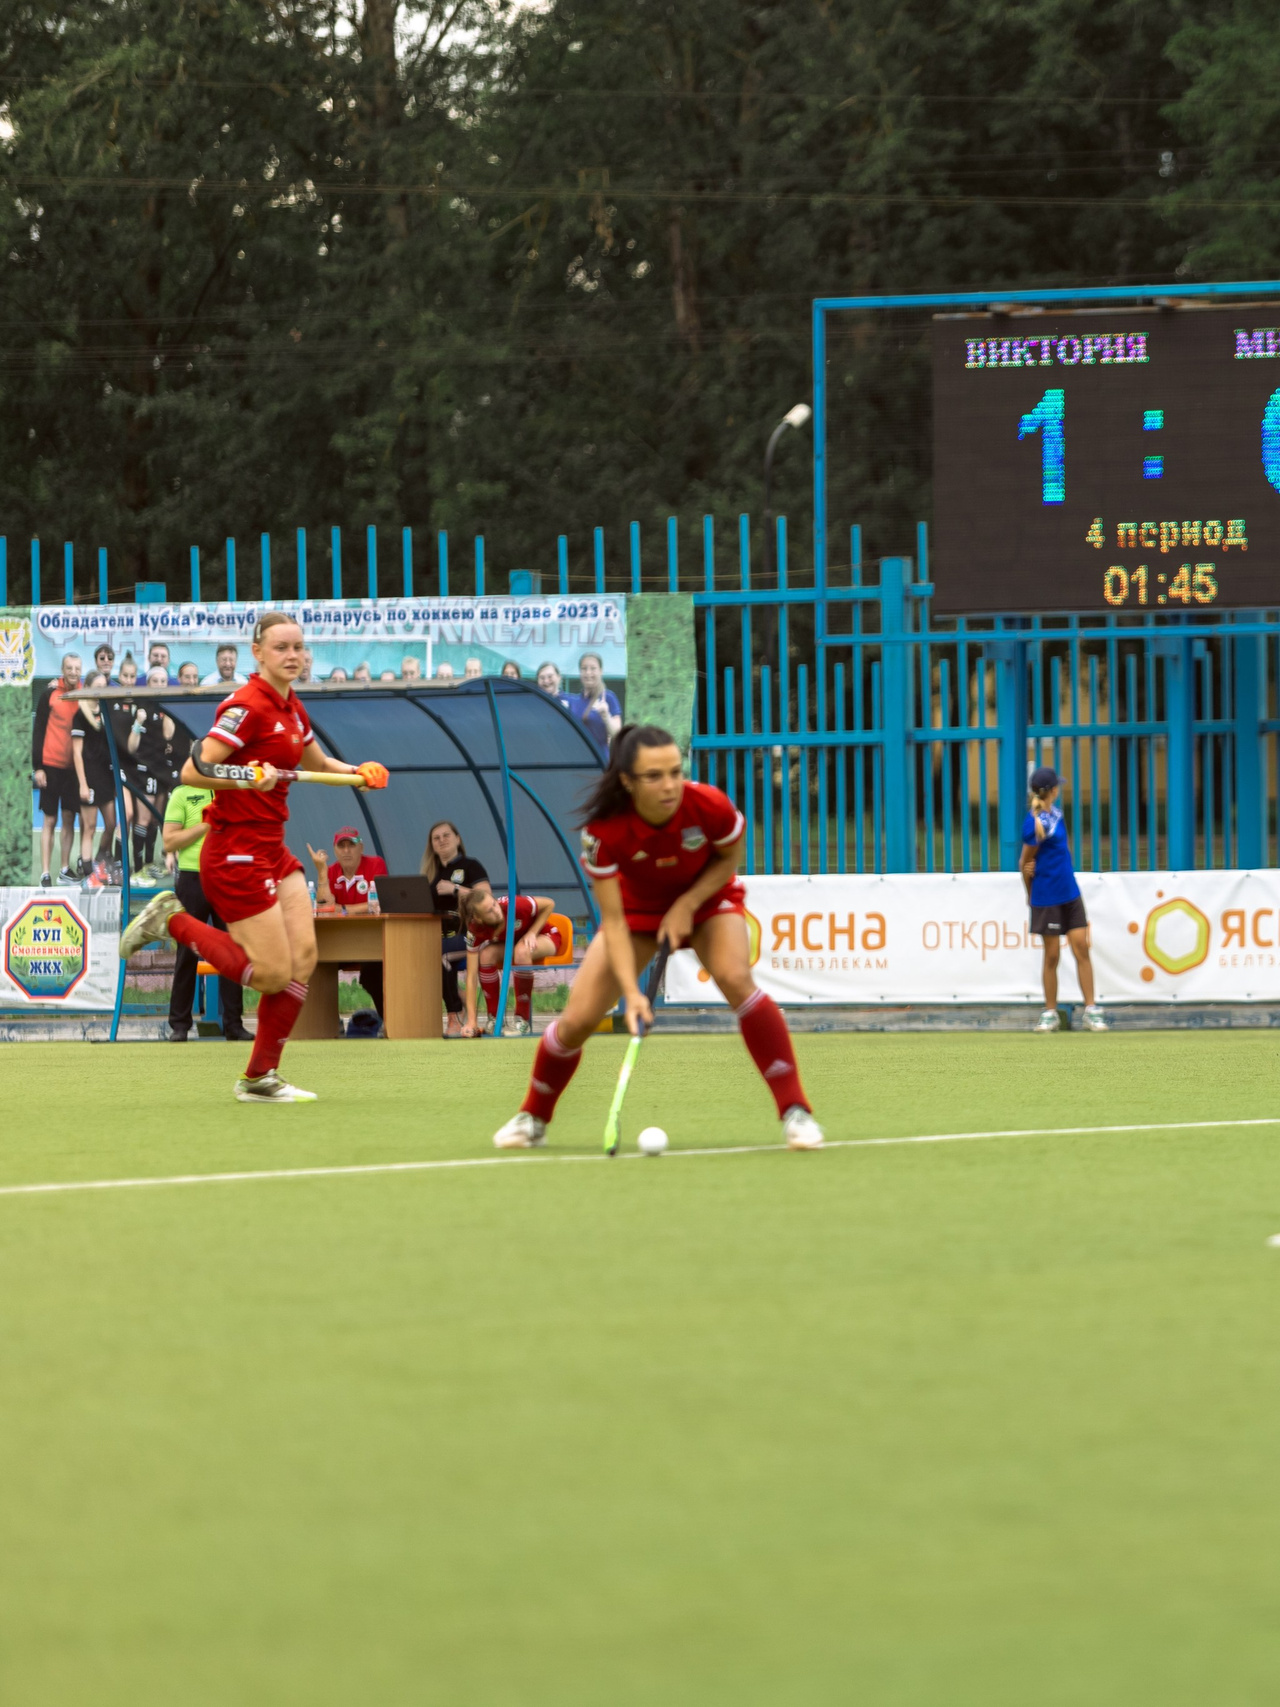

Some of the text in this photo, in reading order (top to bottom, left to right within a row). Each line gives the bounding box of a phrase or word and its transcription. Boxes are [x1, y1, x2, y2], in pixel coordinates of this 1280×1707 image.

[965, 332, 1150, 369] ВИКТОРИЯ
[1018, 388, 1067, 507] 1
[1085, 517, 1106, 549] 4
[1103, 562, 1219, 606] 01:45
[40, 610, 135, 631] Обладатели
[139, 608, 191, 631] Кубка
[302, 607, 382, 627] Беларусь
[387, 607, 407, 622] по
[412, 606, 475, 622] хоккею
[480, 607, 499, 621] на
[503, 605, 552, 624] траве
[557, 602, 599, 619] 2023
[604, 603, 618, 618] г.
[32, 928, 62, 942] КУП
[11, 944, 82, 956] Смолевичское
[770, 956, 889, 970] БЕЛТЭЛЕКАМ
[29, 960, 62, 975] ЖКХ
